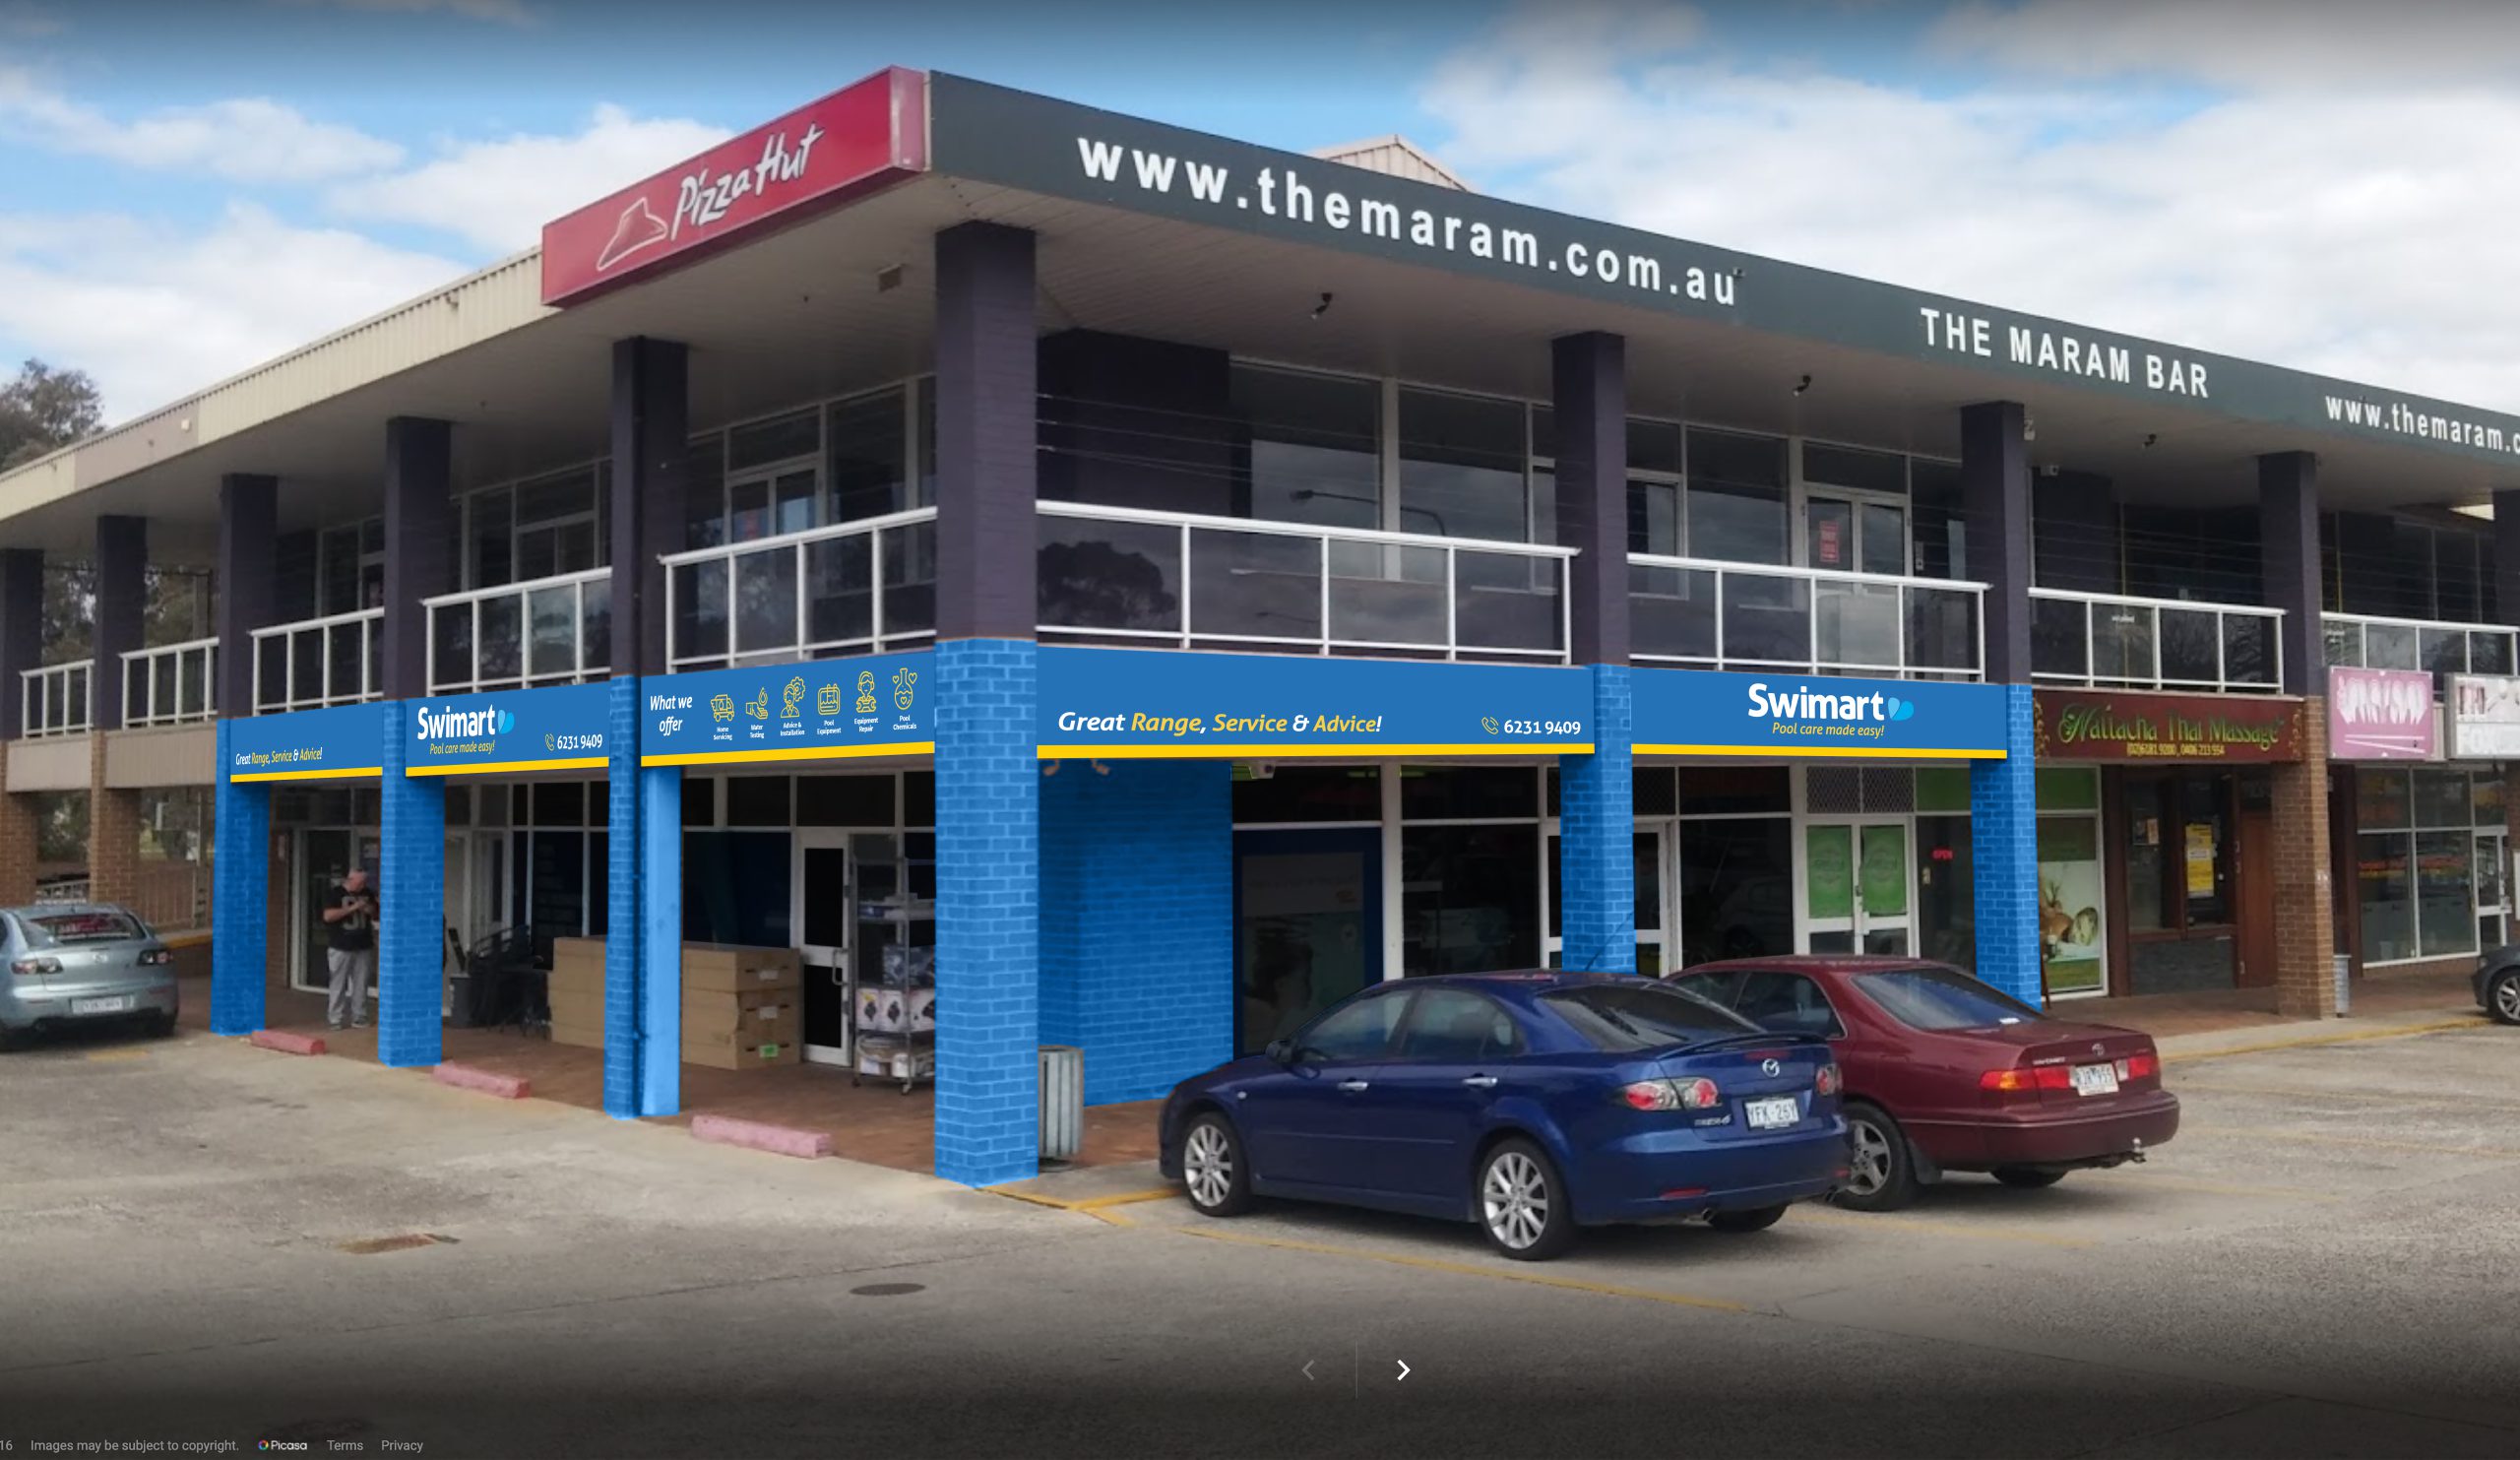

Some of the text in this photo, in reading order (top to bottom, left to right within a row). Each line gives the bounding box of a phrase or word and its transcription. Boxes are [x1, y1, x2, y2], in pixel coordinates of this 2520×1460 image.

[671, 123, 824, 241] Pizza Hut
[1077, 137, 1734, 305] www.themaram.com.au
[1921, 307, 2209, 398] THE MARAM BAR
[650, 694, 693, 711] What we
[1748, 682, 1885, 721] Swimart
[417, 704, 495, 739] Swimart
[659, 716, 683, 736] offer
[817, 727, 842, 735] Equipment
[1058, 712, 1382, 736] Great Range, Service & Advice!
[1503, 720, 1581, 734] 6231 9409
[1772, 723, 1885, 738] Pool care made easy!
[429, 739, 495, 755] Pool care made easy!
[557, 733, 602, 750] 6231 9409
[235, 753, 251, 766] Great
[251, 751, 271, 767] Range,
[271, 750, 292, 763] Service
[293, 748, 299, 761] &
